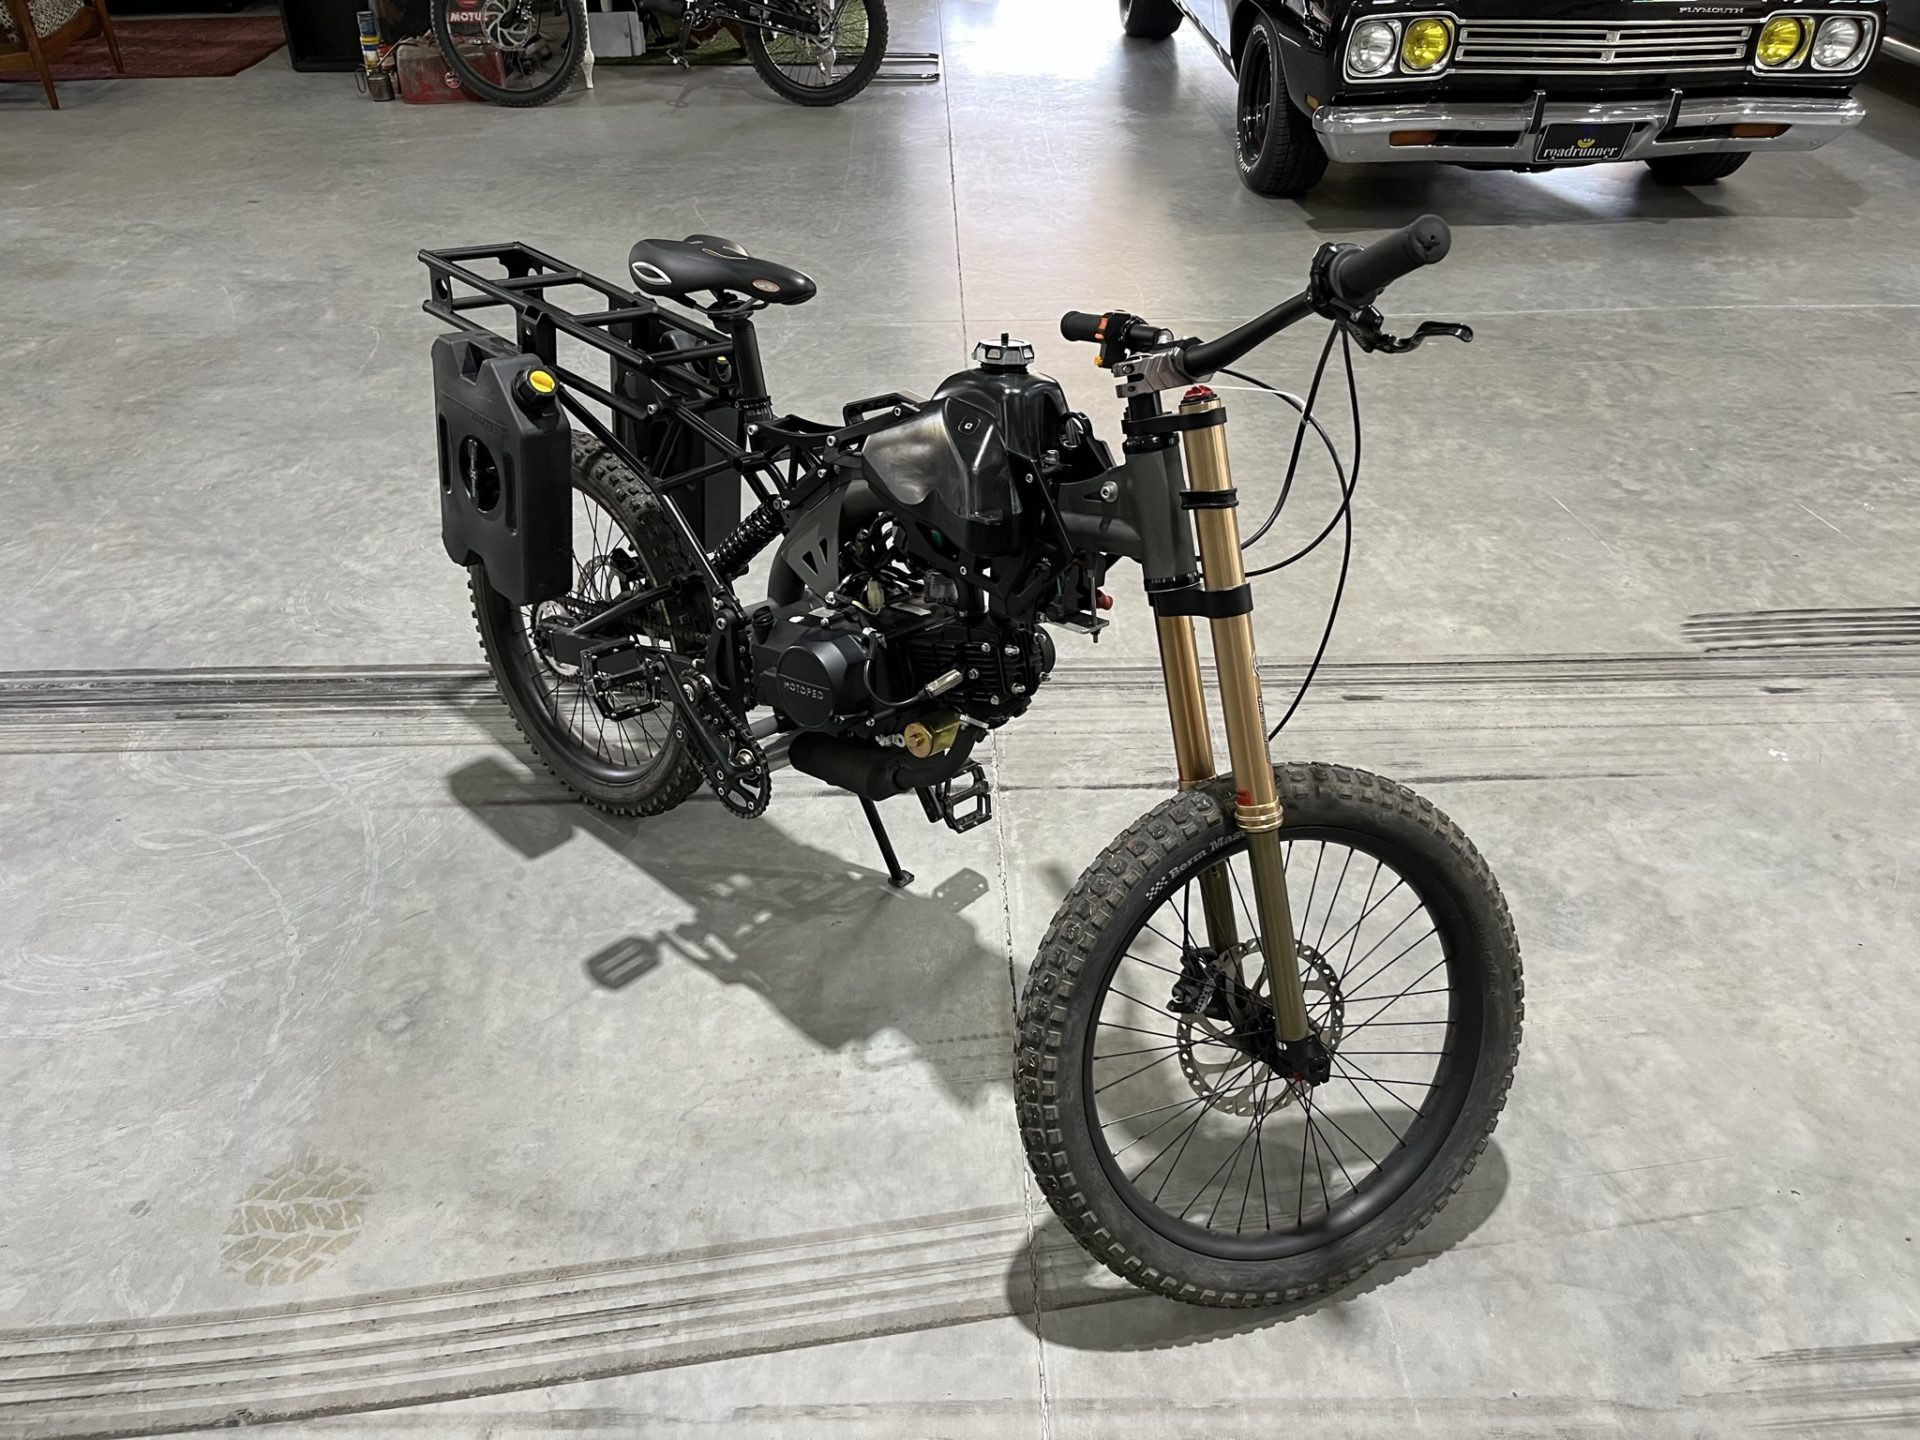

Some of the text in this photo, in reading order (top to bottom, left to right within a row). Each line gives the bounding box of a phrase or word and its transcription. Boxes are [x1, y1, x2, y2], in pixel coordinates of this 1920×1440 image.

[450, 11, 488, 22] MOTU
[1543, 145, 1618, 158] roadrunner
[783, 681, 824, 700] MOTOPED
[1168, 849, 1208, 880] Berm
